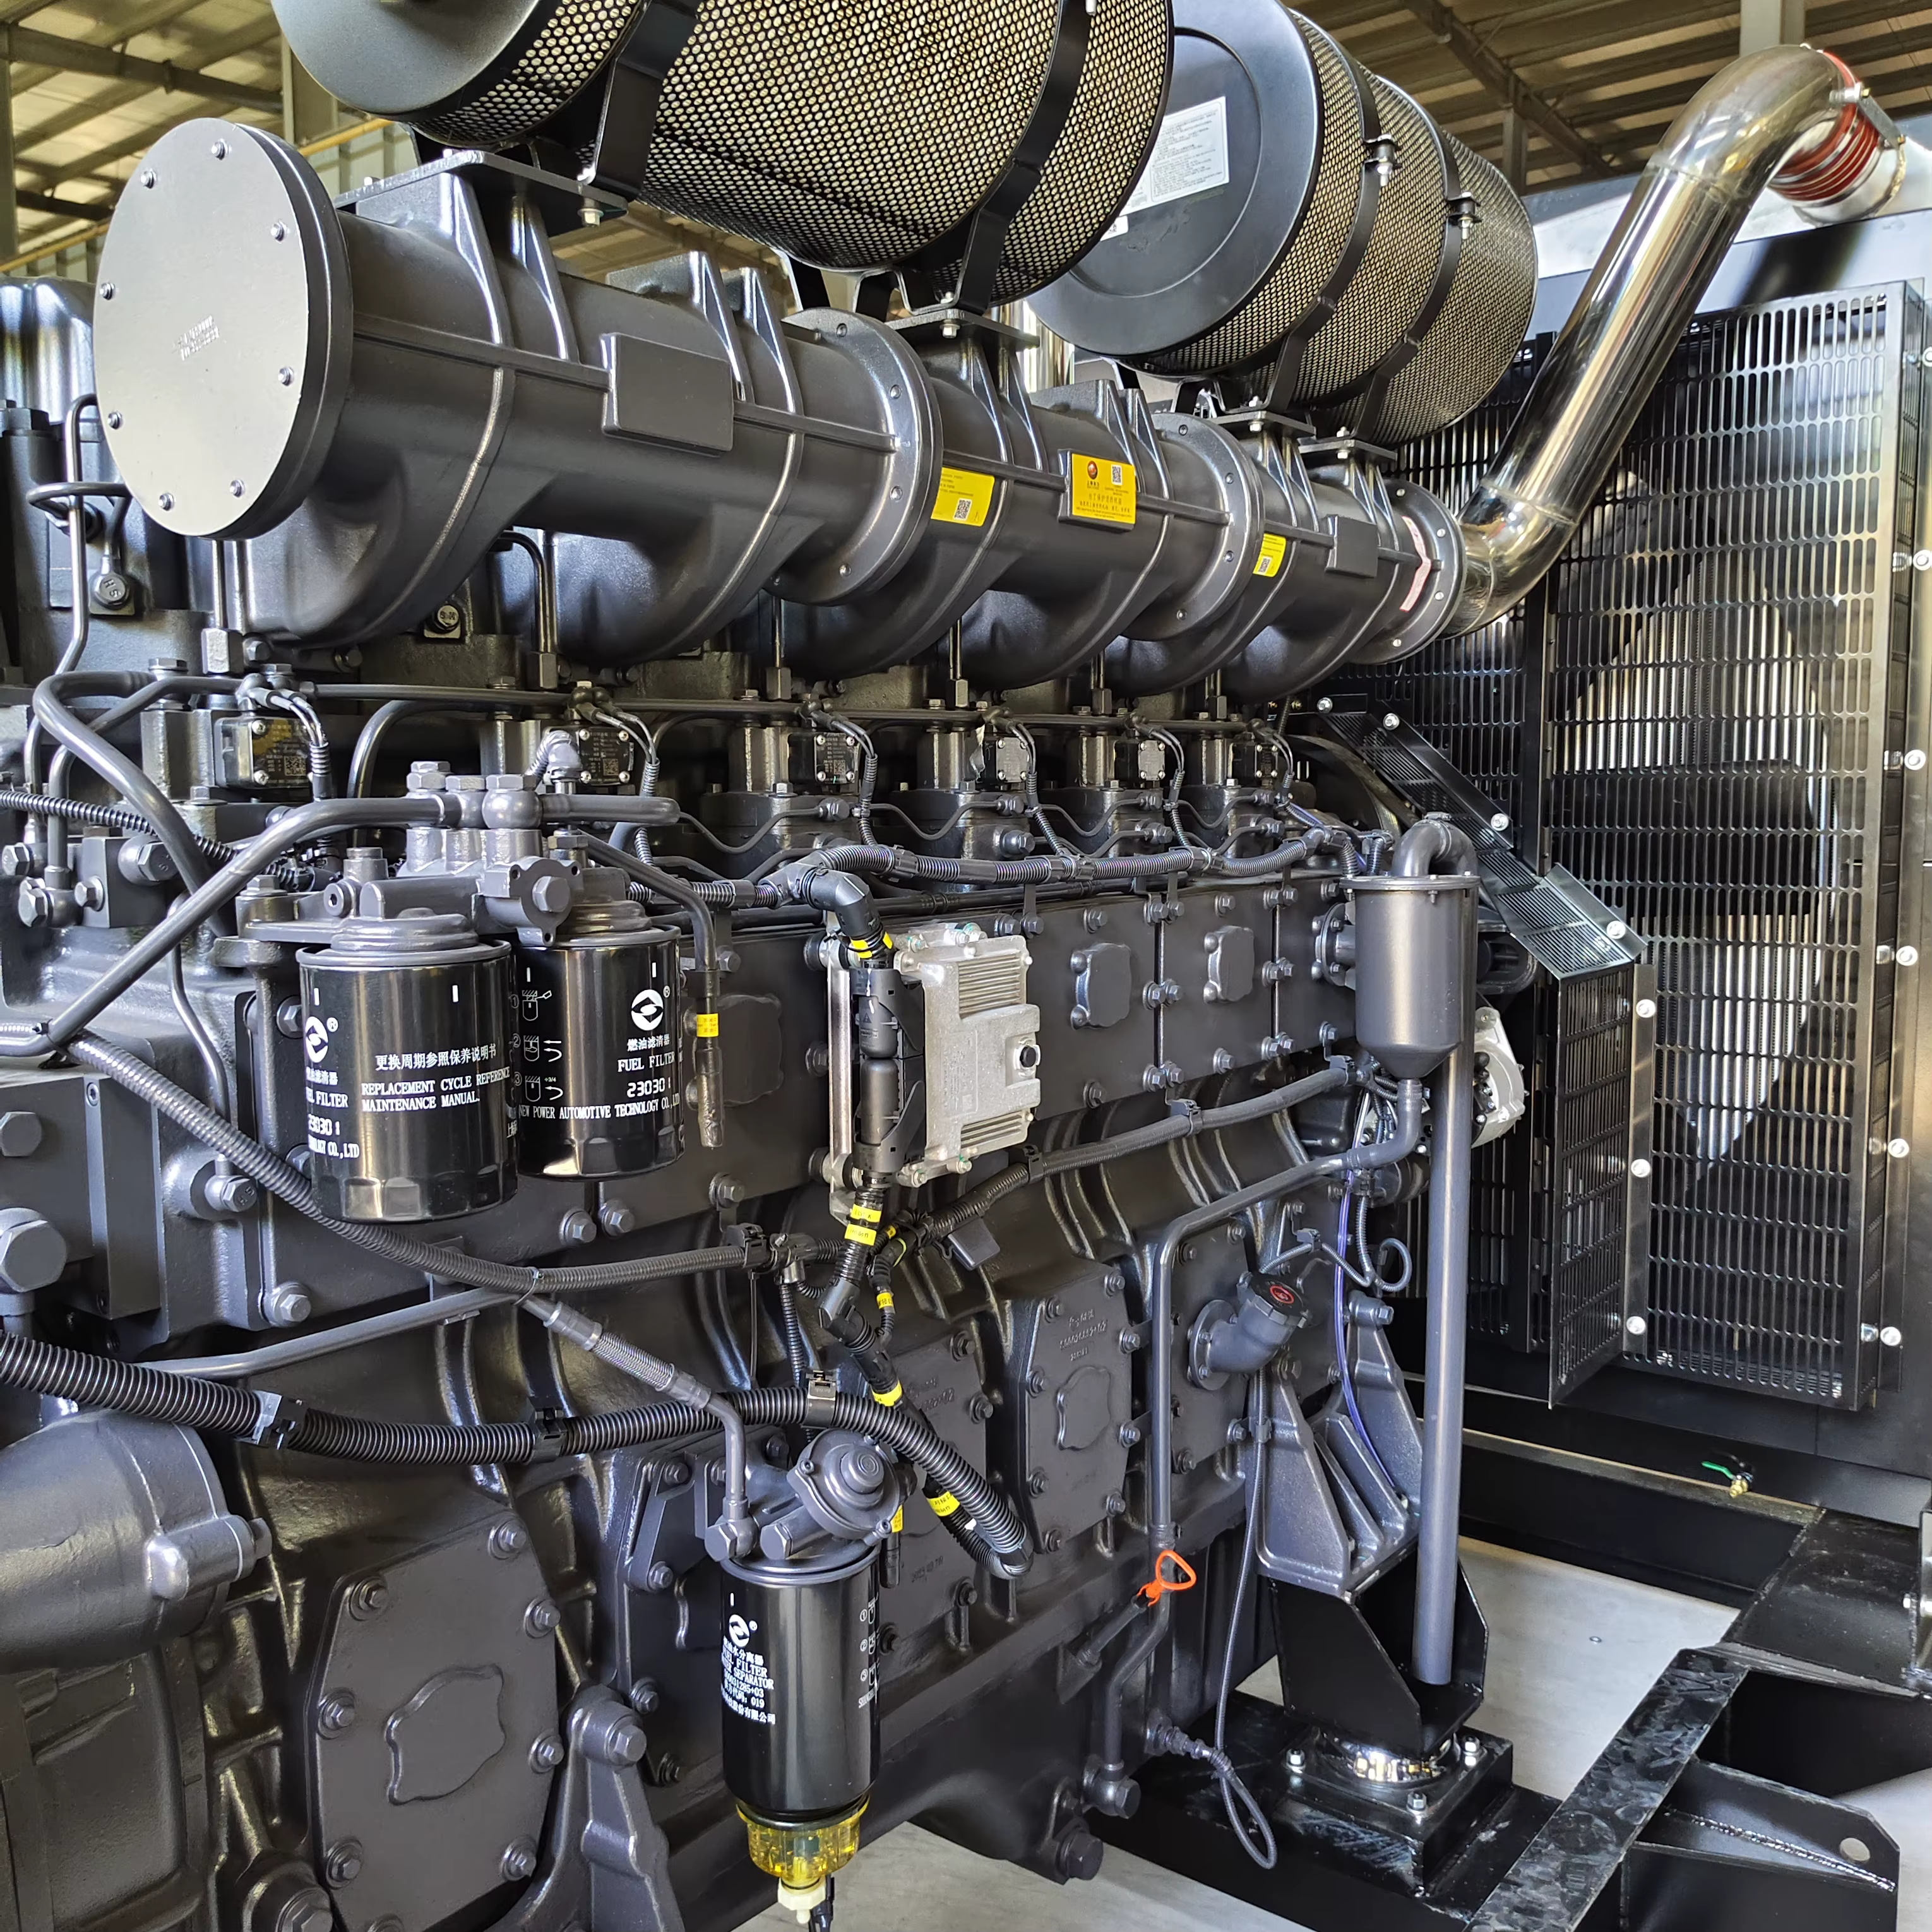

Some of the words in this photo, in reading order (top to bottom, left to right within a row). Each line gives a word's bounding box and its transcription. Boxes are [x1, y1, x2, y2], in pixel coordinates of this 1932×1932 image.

[627, 1034, 670, 1052] 燃油滤清器
[375, 1043, 496, 1071] 更换周期参照保养说明书
[617, 1058, 644, 1073] FUEL
[649, 1051, 675, 1068] FILTER
[362, 1080, 435, 1096] REPLACEMENT
[441, 1076, 472, 1092] CYCLE
[316, 1090, 349, 1108] FILTER
[362, 1096, 436, 1112] MAINTENANCE
[441, 1091, 480, 1107] MANUAL.
[519, 1105, 530, 1118] NEW
[533, 1106, 556, 1119] POWER
[559, 1106, 611, 1119] AUTOMOTIVE
[614, 1099, 659, 1117] TECHNOLOGY
[736, 1657, 767, 1678] FILTER
[734, 1667, 774, 1690] SEPARATOR
[751, 1697, 765, 1708] 019
